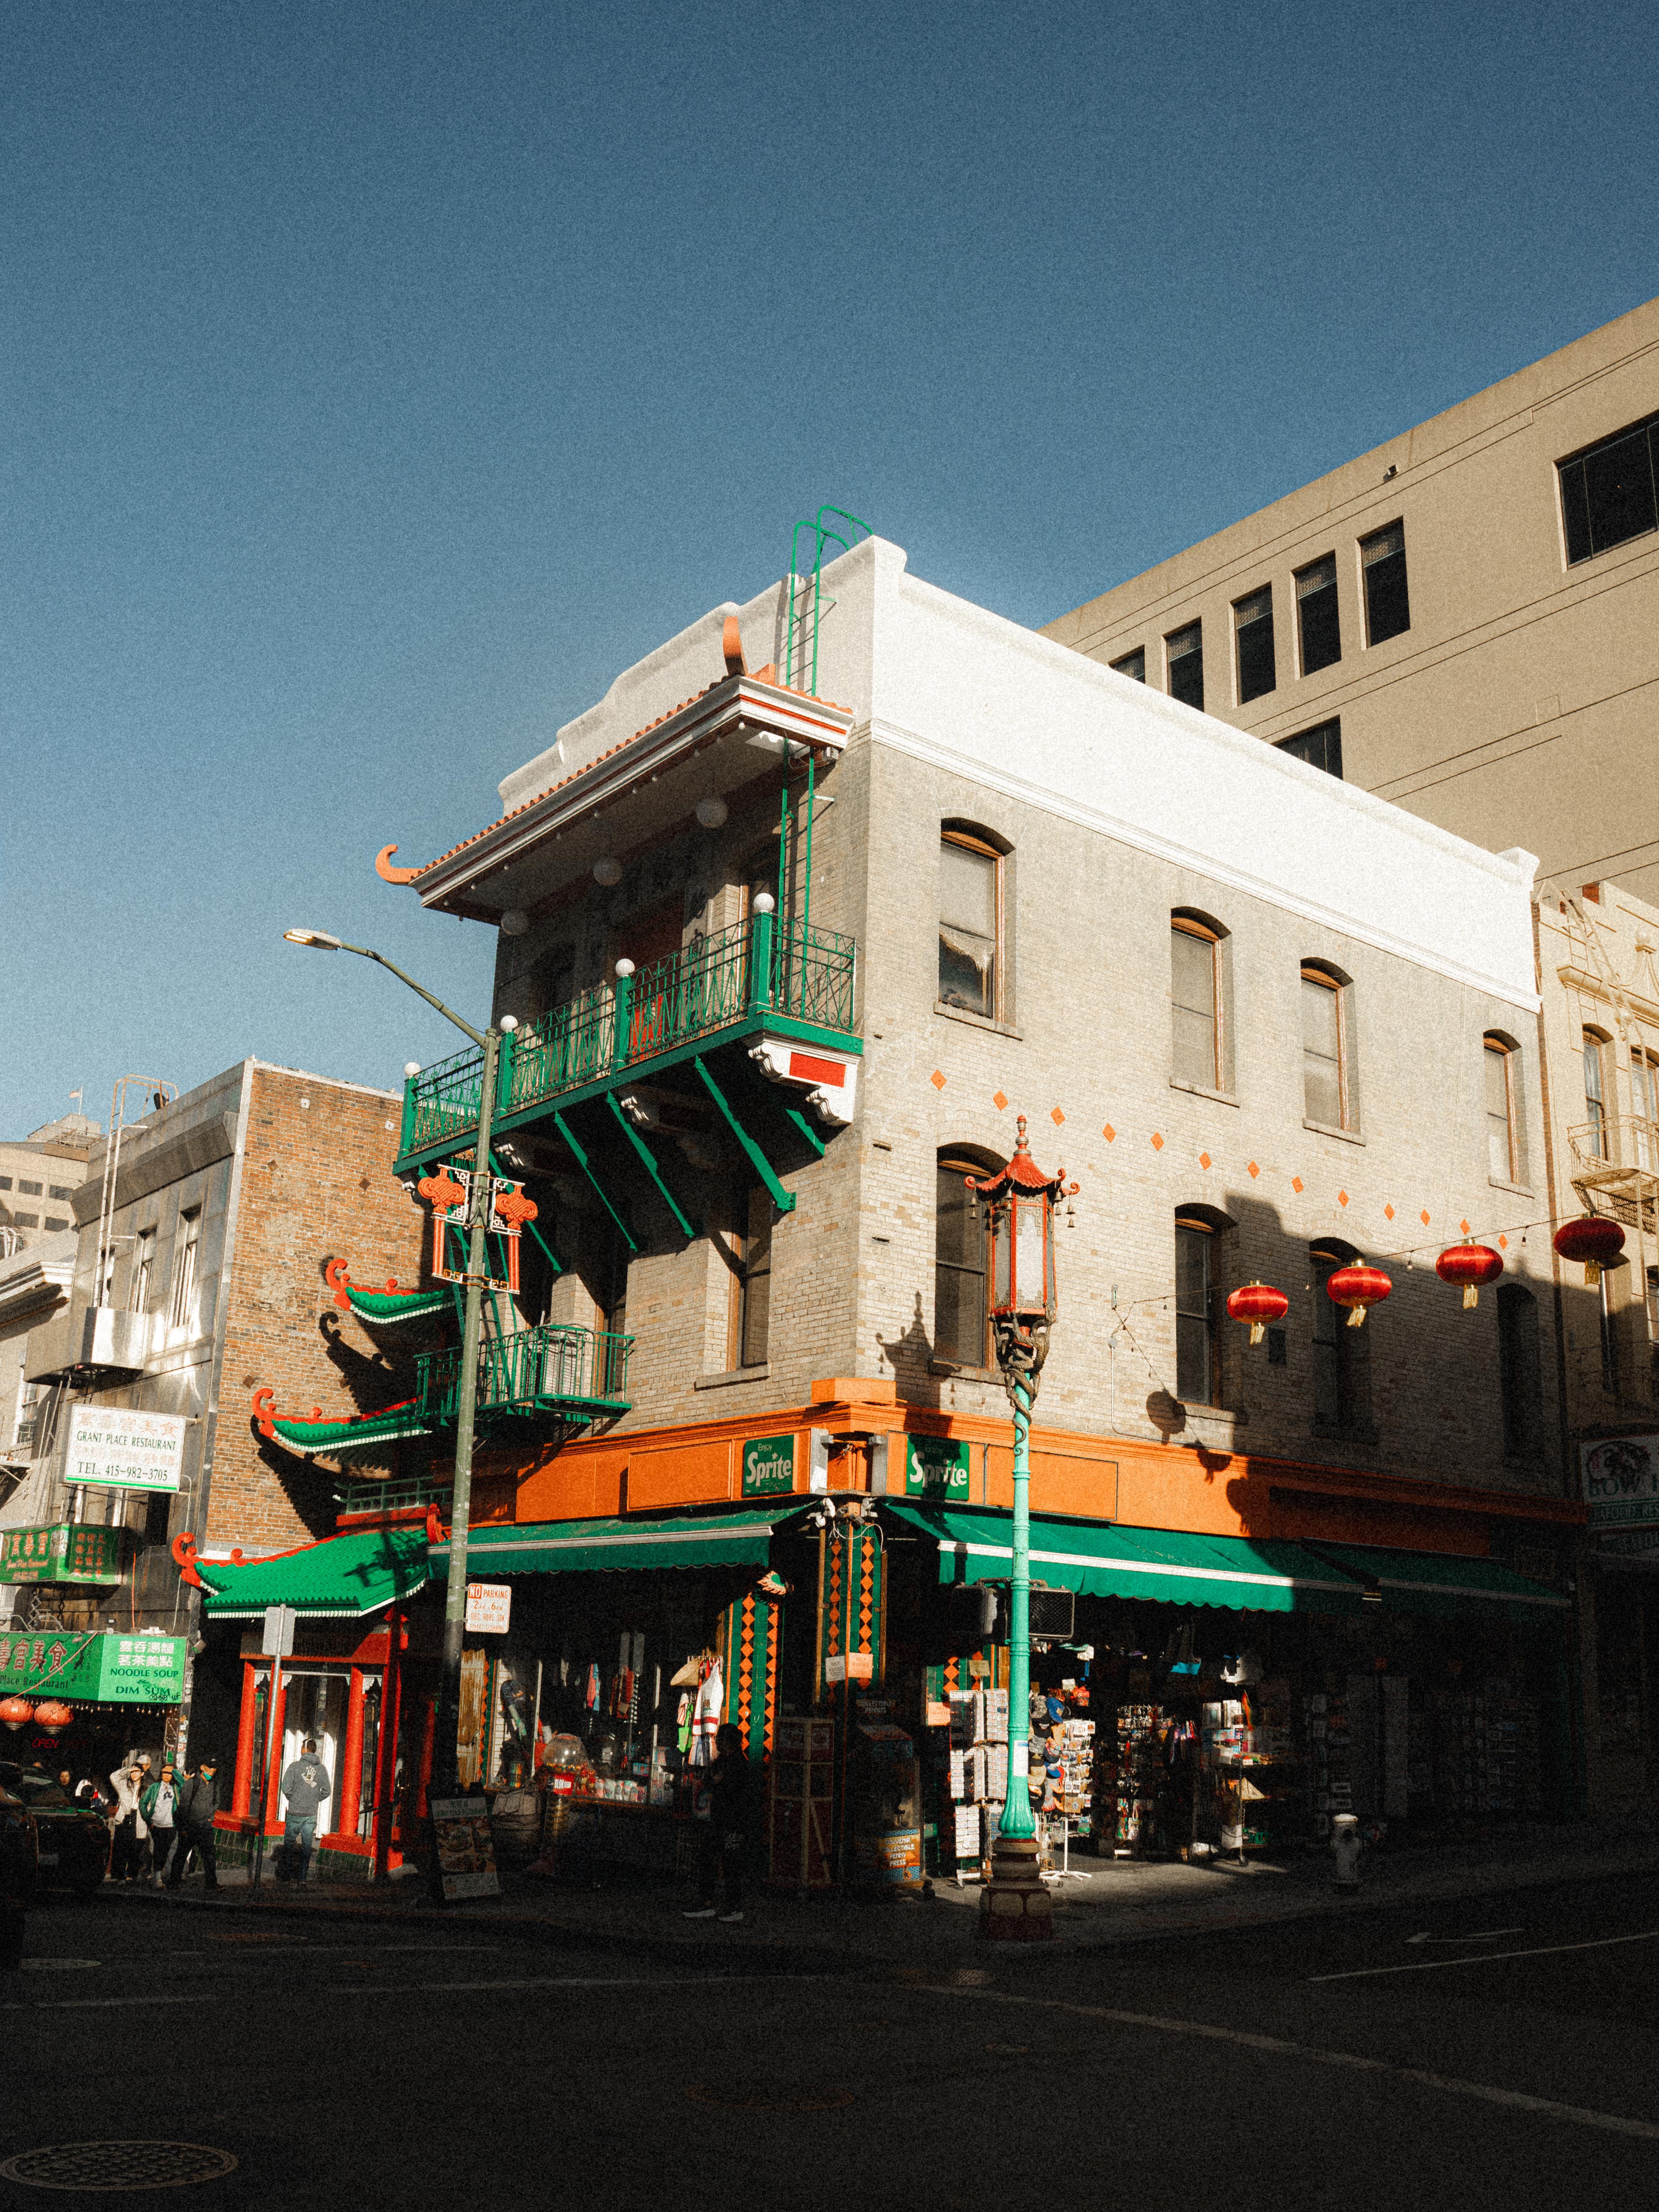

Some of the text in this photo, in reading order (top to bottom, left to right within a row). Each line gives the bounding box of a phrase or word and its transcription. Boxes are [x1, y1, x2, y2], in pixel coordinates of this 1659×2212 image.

[77, 1431, 176, 1451] GRANT PLACE RESTAURANT
[758, 1443, 772, 1452] Enjoy
[925, 1444, 943, 1454] Enjoy
[78, 1462, 167, 1481] TEL. 415-982-3705
[746, 1452, 792, 1487] Sprite
[909, 1451, 967, 1488] Sprite
[470, 1586, 508, 1599] NO PARKING
[110, 1669, 150, 1677] NOODLE
[23, 1676, 69, 1689] Restaurant
[116, 1686, 170, 1696] DIM SUM
[32, 1738, 60, 1748] OPEN
[882, 1844, 914, 1853] COLLECTIBLE
